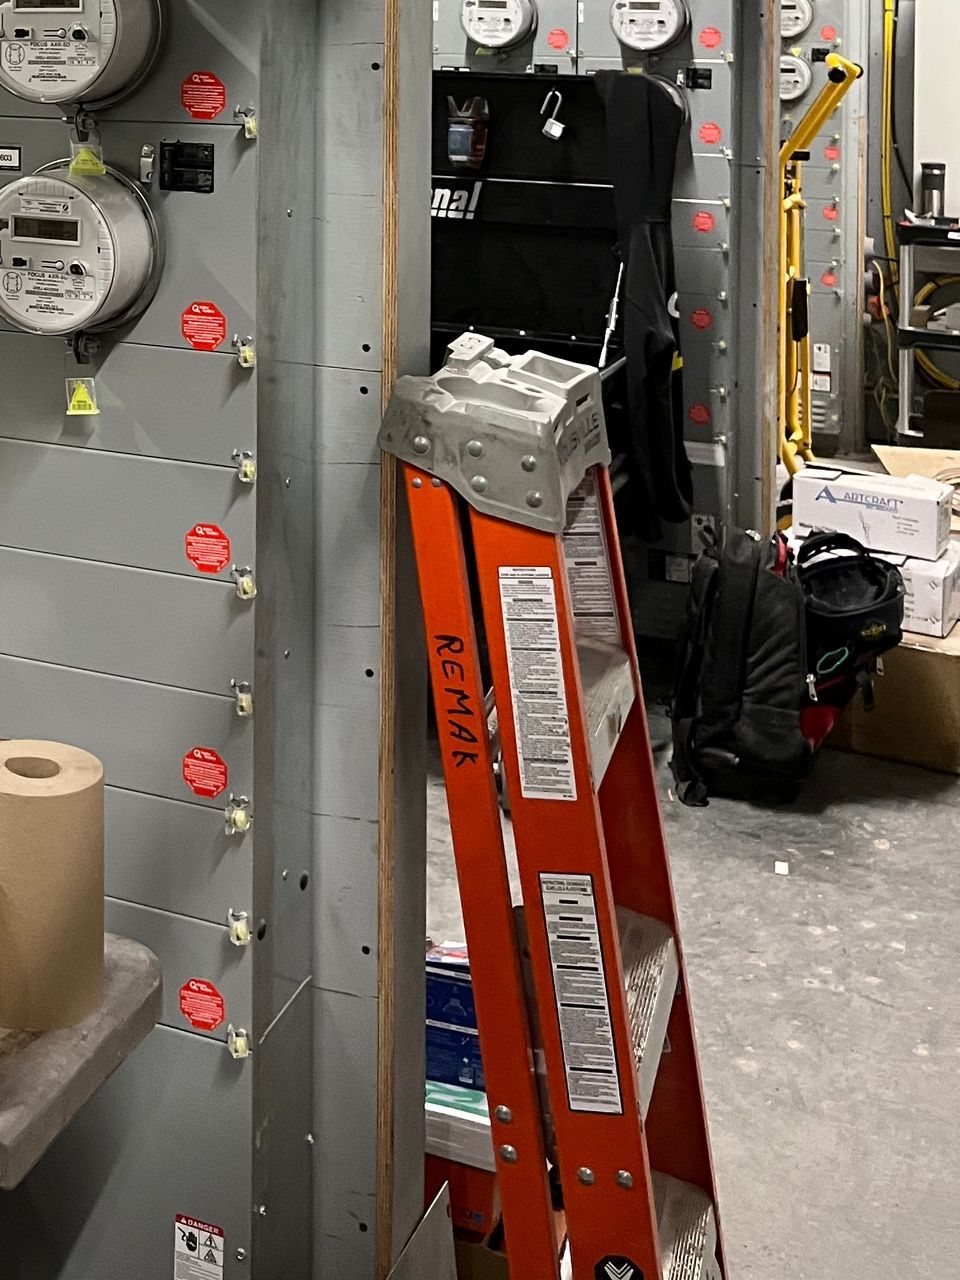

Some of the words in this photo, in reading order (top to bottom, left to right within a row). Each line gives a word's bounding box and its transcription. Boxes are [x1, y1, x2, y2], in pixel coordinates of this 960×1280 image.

[0, 154, 13, 162] 603
[431, 181, 483, 220] nal
[434, 634, 479, 768] REMAK
[187, 1219, 219, 1234] DANGER
